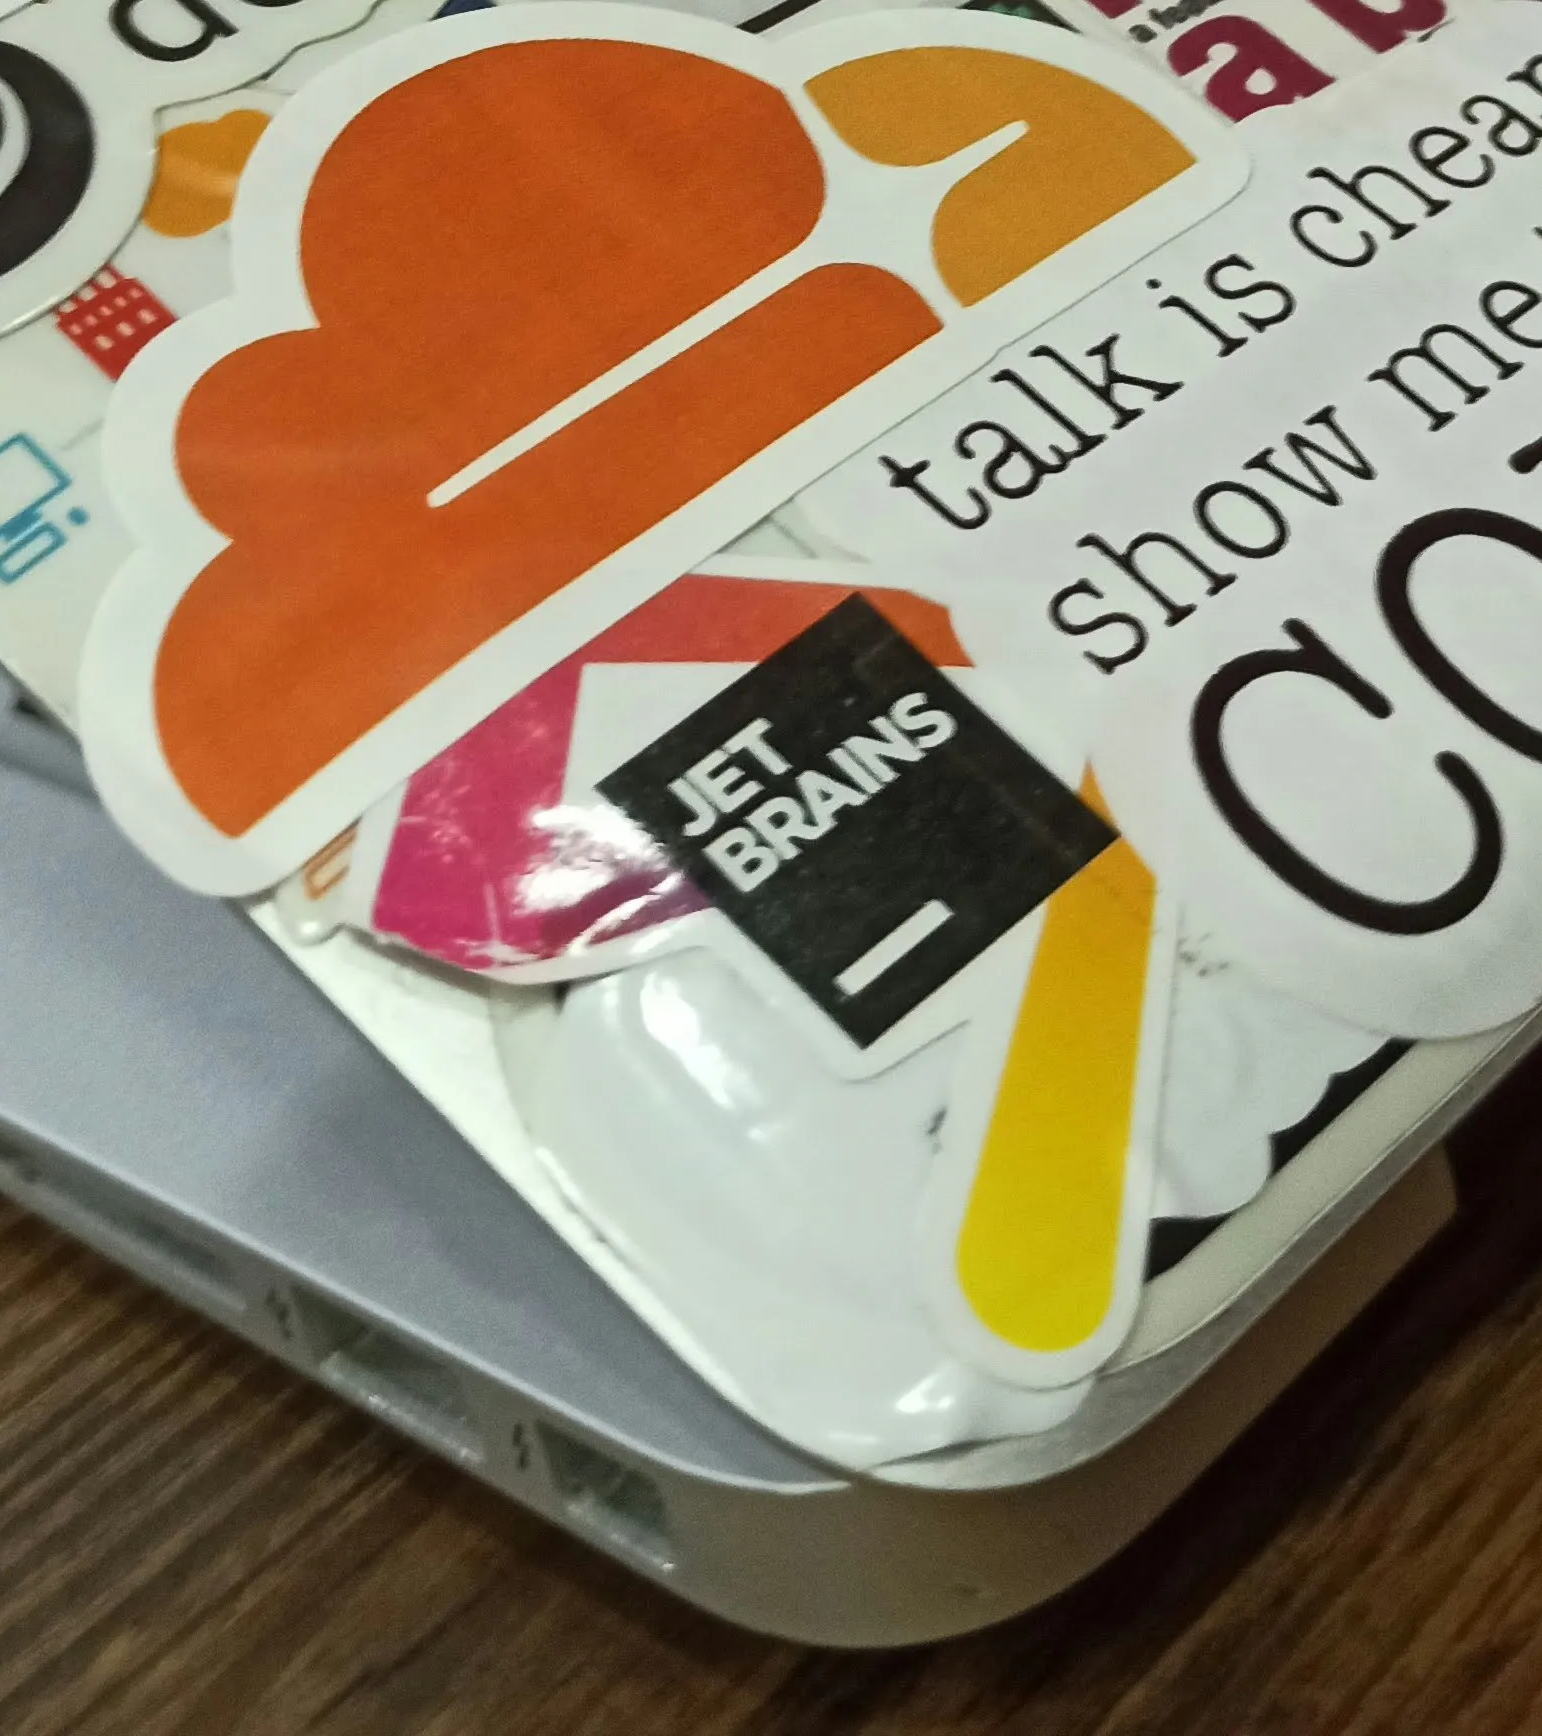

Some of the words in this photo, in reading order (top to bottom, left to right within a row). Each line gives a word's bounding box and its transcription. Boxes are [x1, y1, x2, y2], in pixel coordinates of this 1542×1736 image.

[1166, 14, 1336, 122] a
[878, 341, 1182, 531] talk
[1144, 251, 1297, 355] is
[1047, 404, 1378, 674] show
[667, 717, 794, 837] JET
[700, 690, 958, 894] BRAINS
